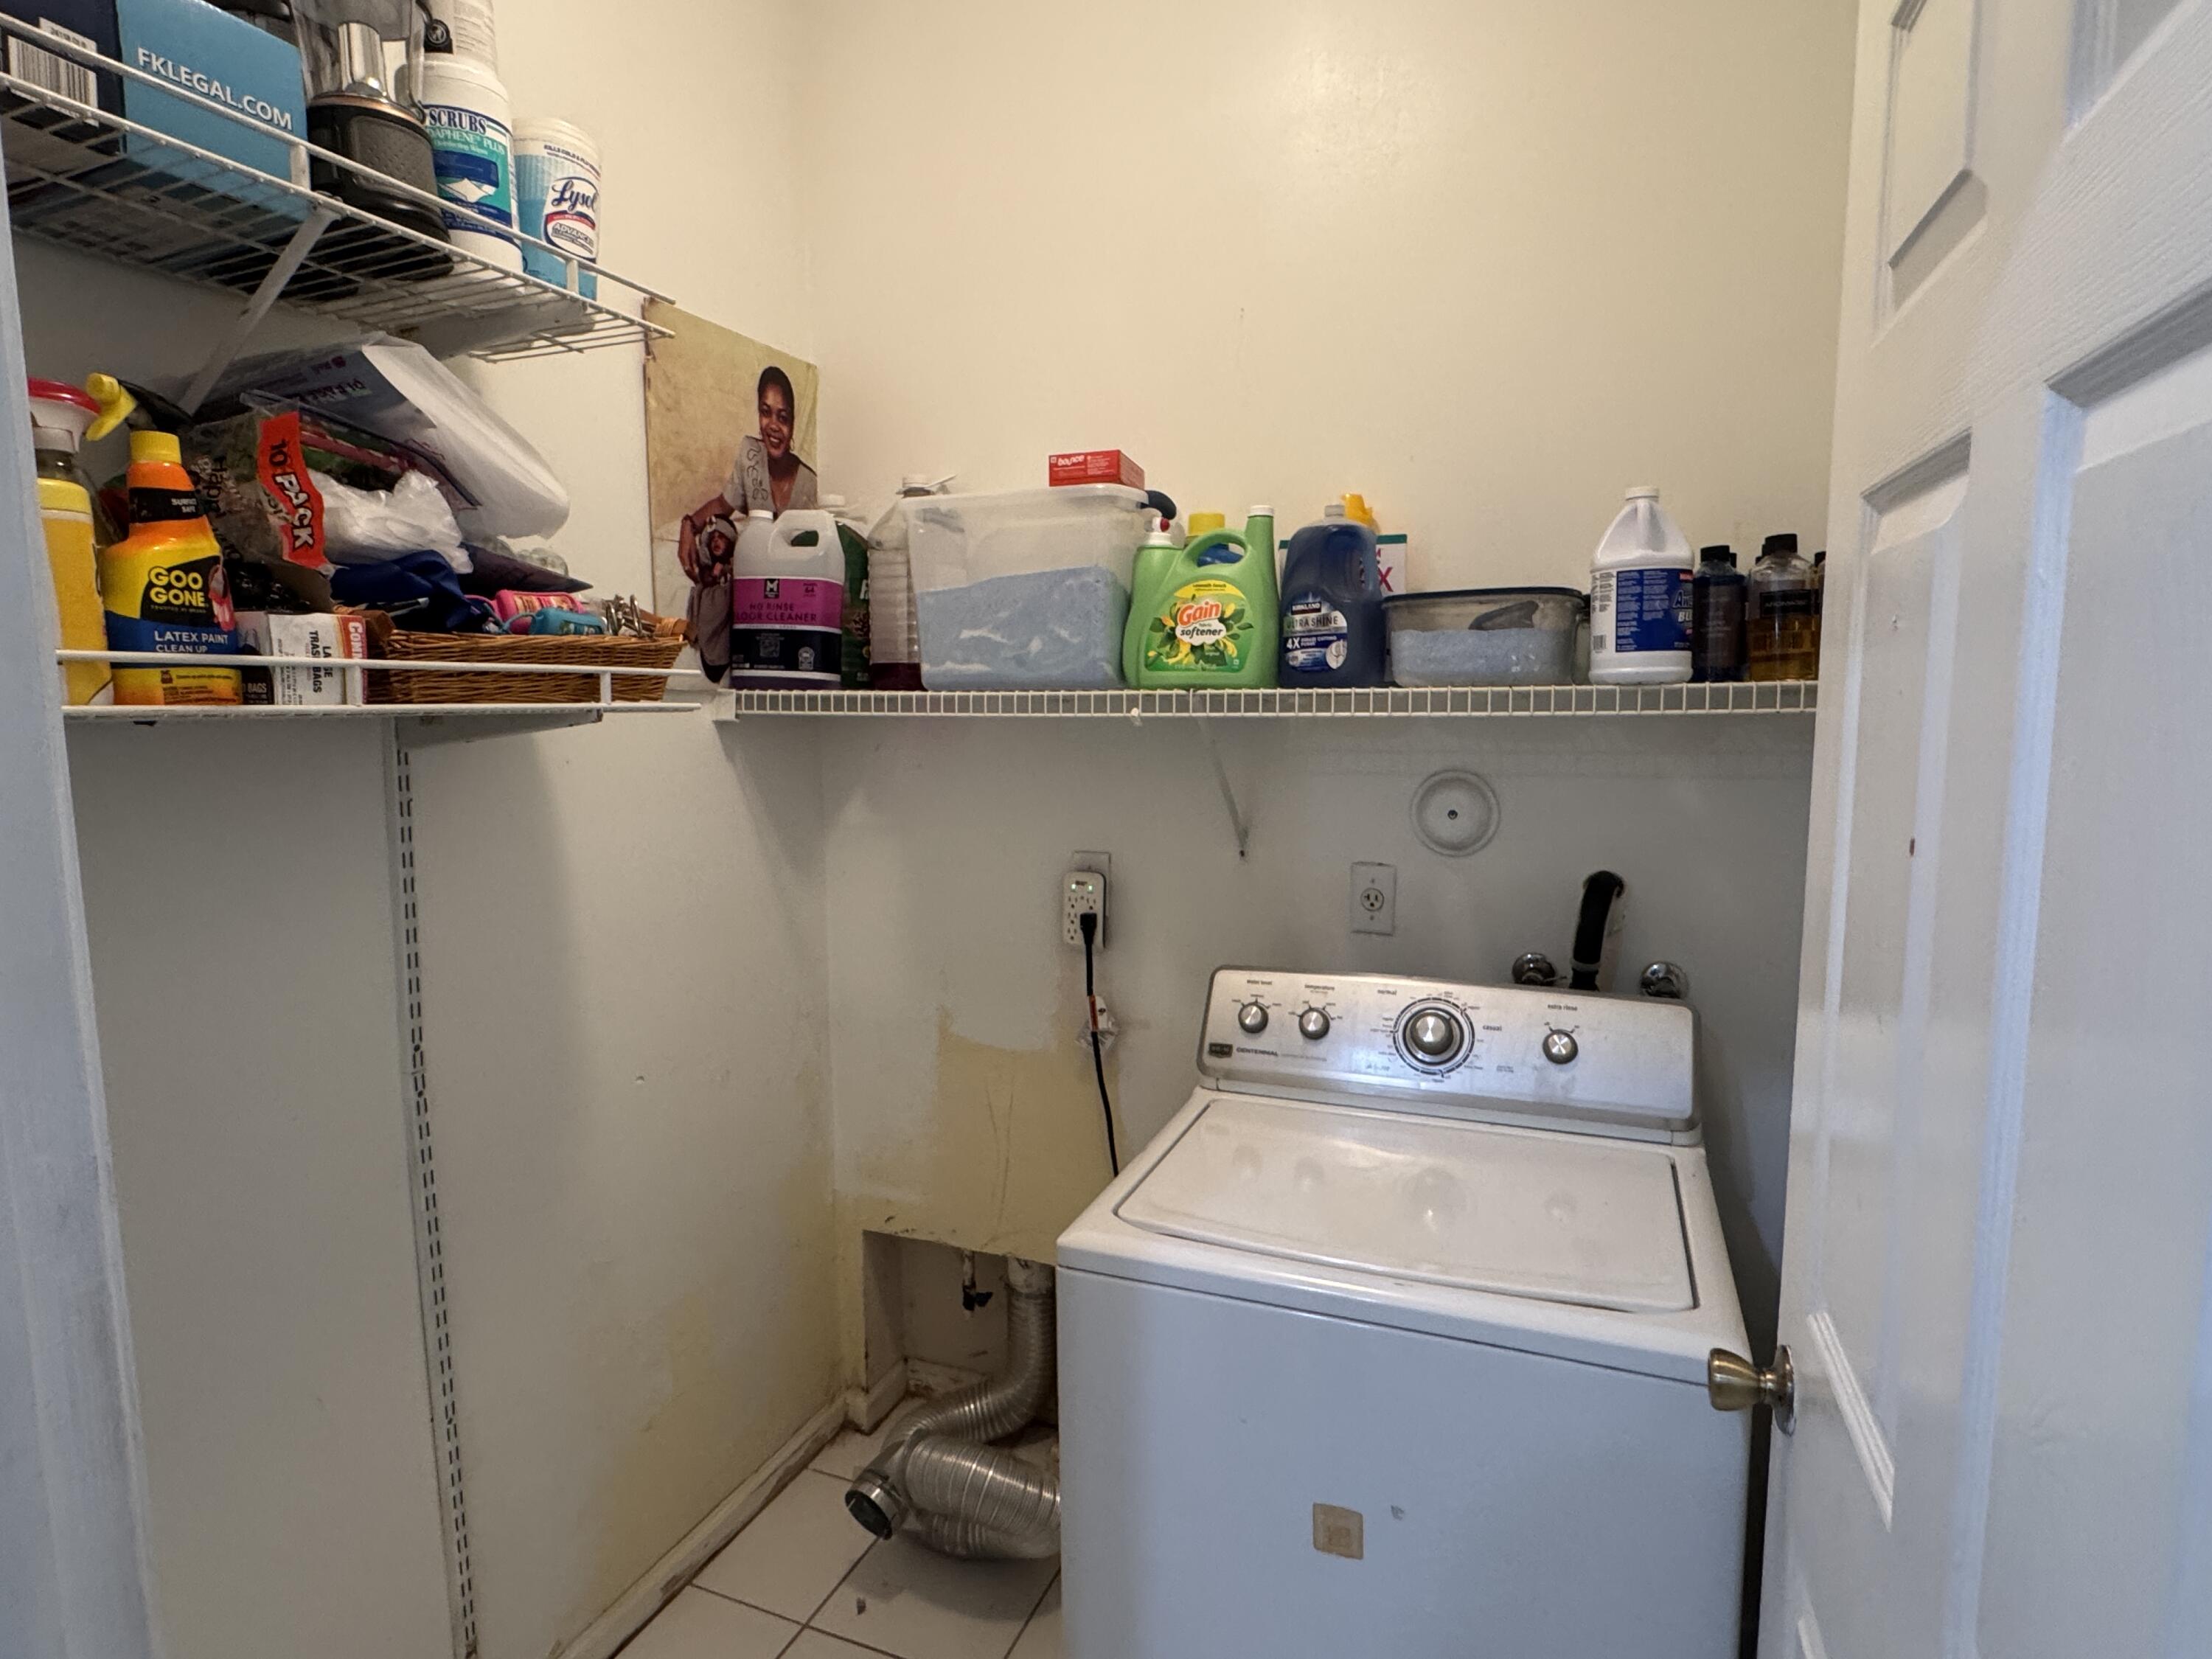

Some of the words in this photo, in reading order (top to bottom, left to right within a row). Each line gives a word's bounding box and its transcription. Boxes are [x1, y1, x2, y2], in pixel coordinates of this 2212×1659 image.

[138, 47, 293, 131] FKLEGAL.COM
[429, 108, 487, 136] SCRUBS
[551, 180, 597, 213] Lysol
[269, 439, 288, 467] 10
[1058, 454, 1085, 466] bounce
[274, 472, 314, 551] PACK
[149, 566, 204, 590] GOO
[150, 587, 205, 607] GONE
[766, 603, 795, 611] RINSE
[766, 613, 817, 622] CLEANER
[1178, 601, 1221, 626] Gain
[1311, 616, 1339, 628] SHINE
[154, 630, 198, 642] LATEX
[201, 633, 229, 644] PAINT
[1180, 627, 1223, 639] softener
[1286, 636, 1301, 650] 4X
[156, 644, 193, 653] CLEAN
[312, 666, 323, 694] BAGS
